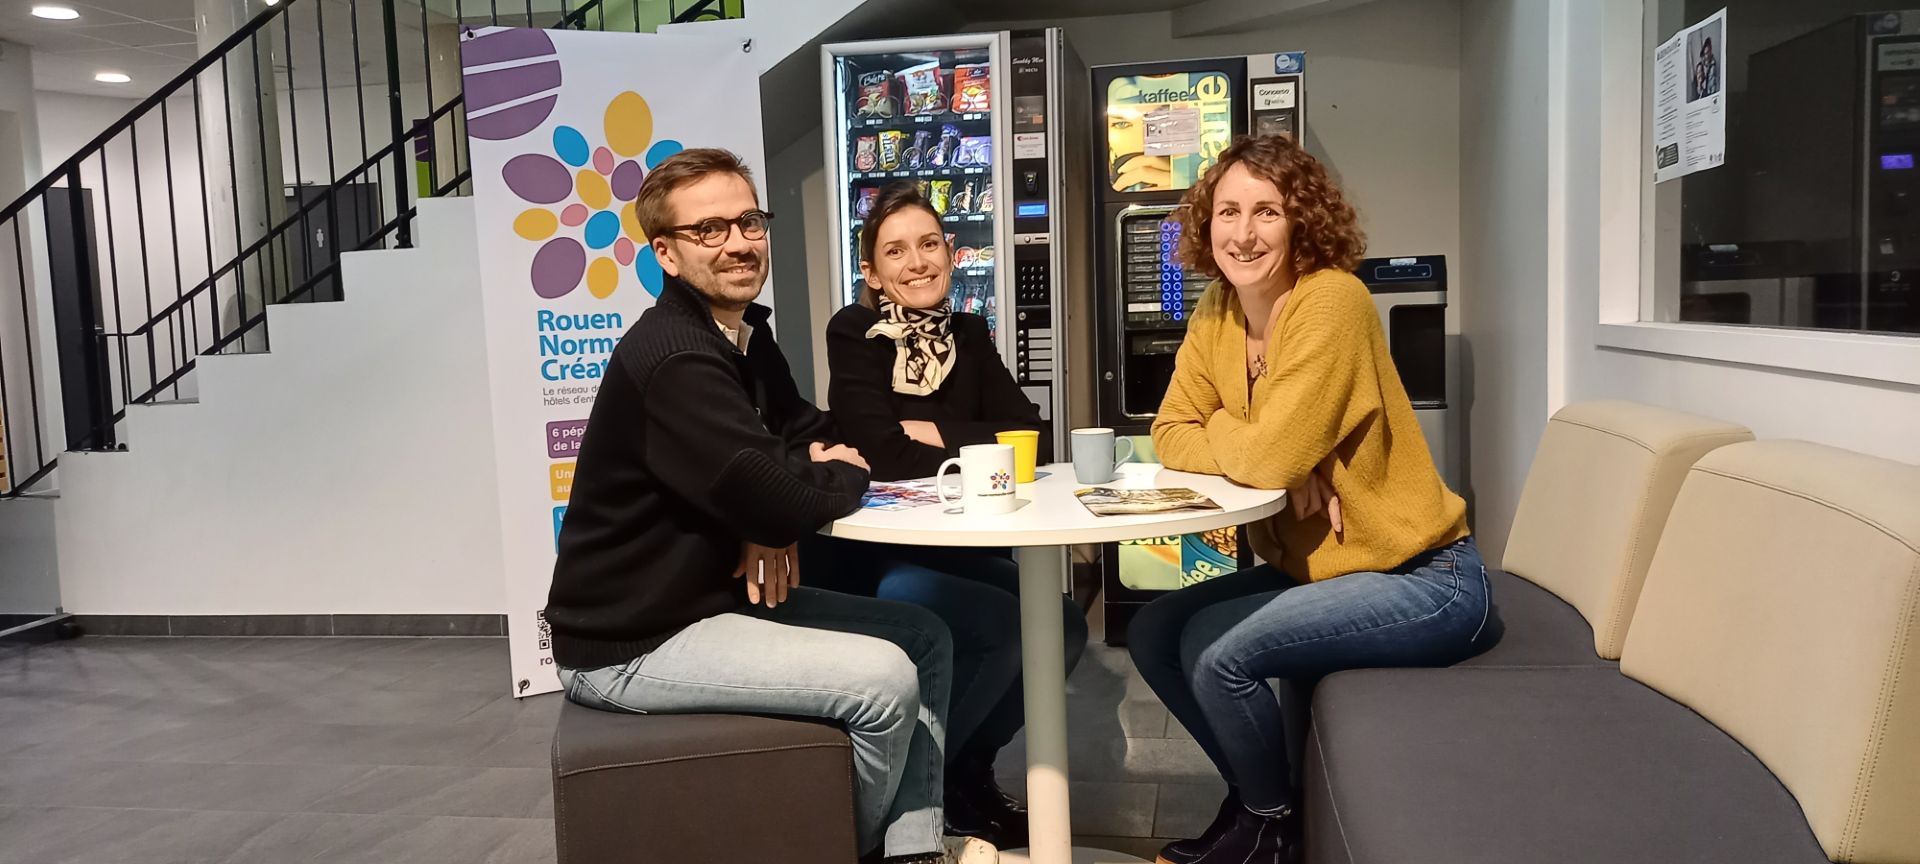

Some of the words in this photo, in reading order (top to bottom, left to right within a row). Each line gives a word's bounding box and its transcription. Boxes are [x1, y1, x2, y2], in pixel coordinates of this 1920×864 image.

[1139, 88, 1190, 103] kaffee
[537, 309, 622, 331] Rouen
[539, 335, 621, 356] Norm
[543, 387, 555, 395] Le
[557, 386, 588, 395] réseau
[543, 397, 571, 406] hôtels
[552, 428, 559, 437] 6
[553, 441, 568, 451] de
